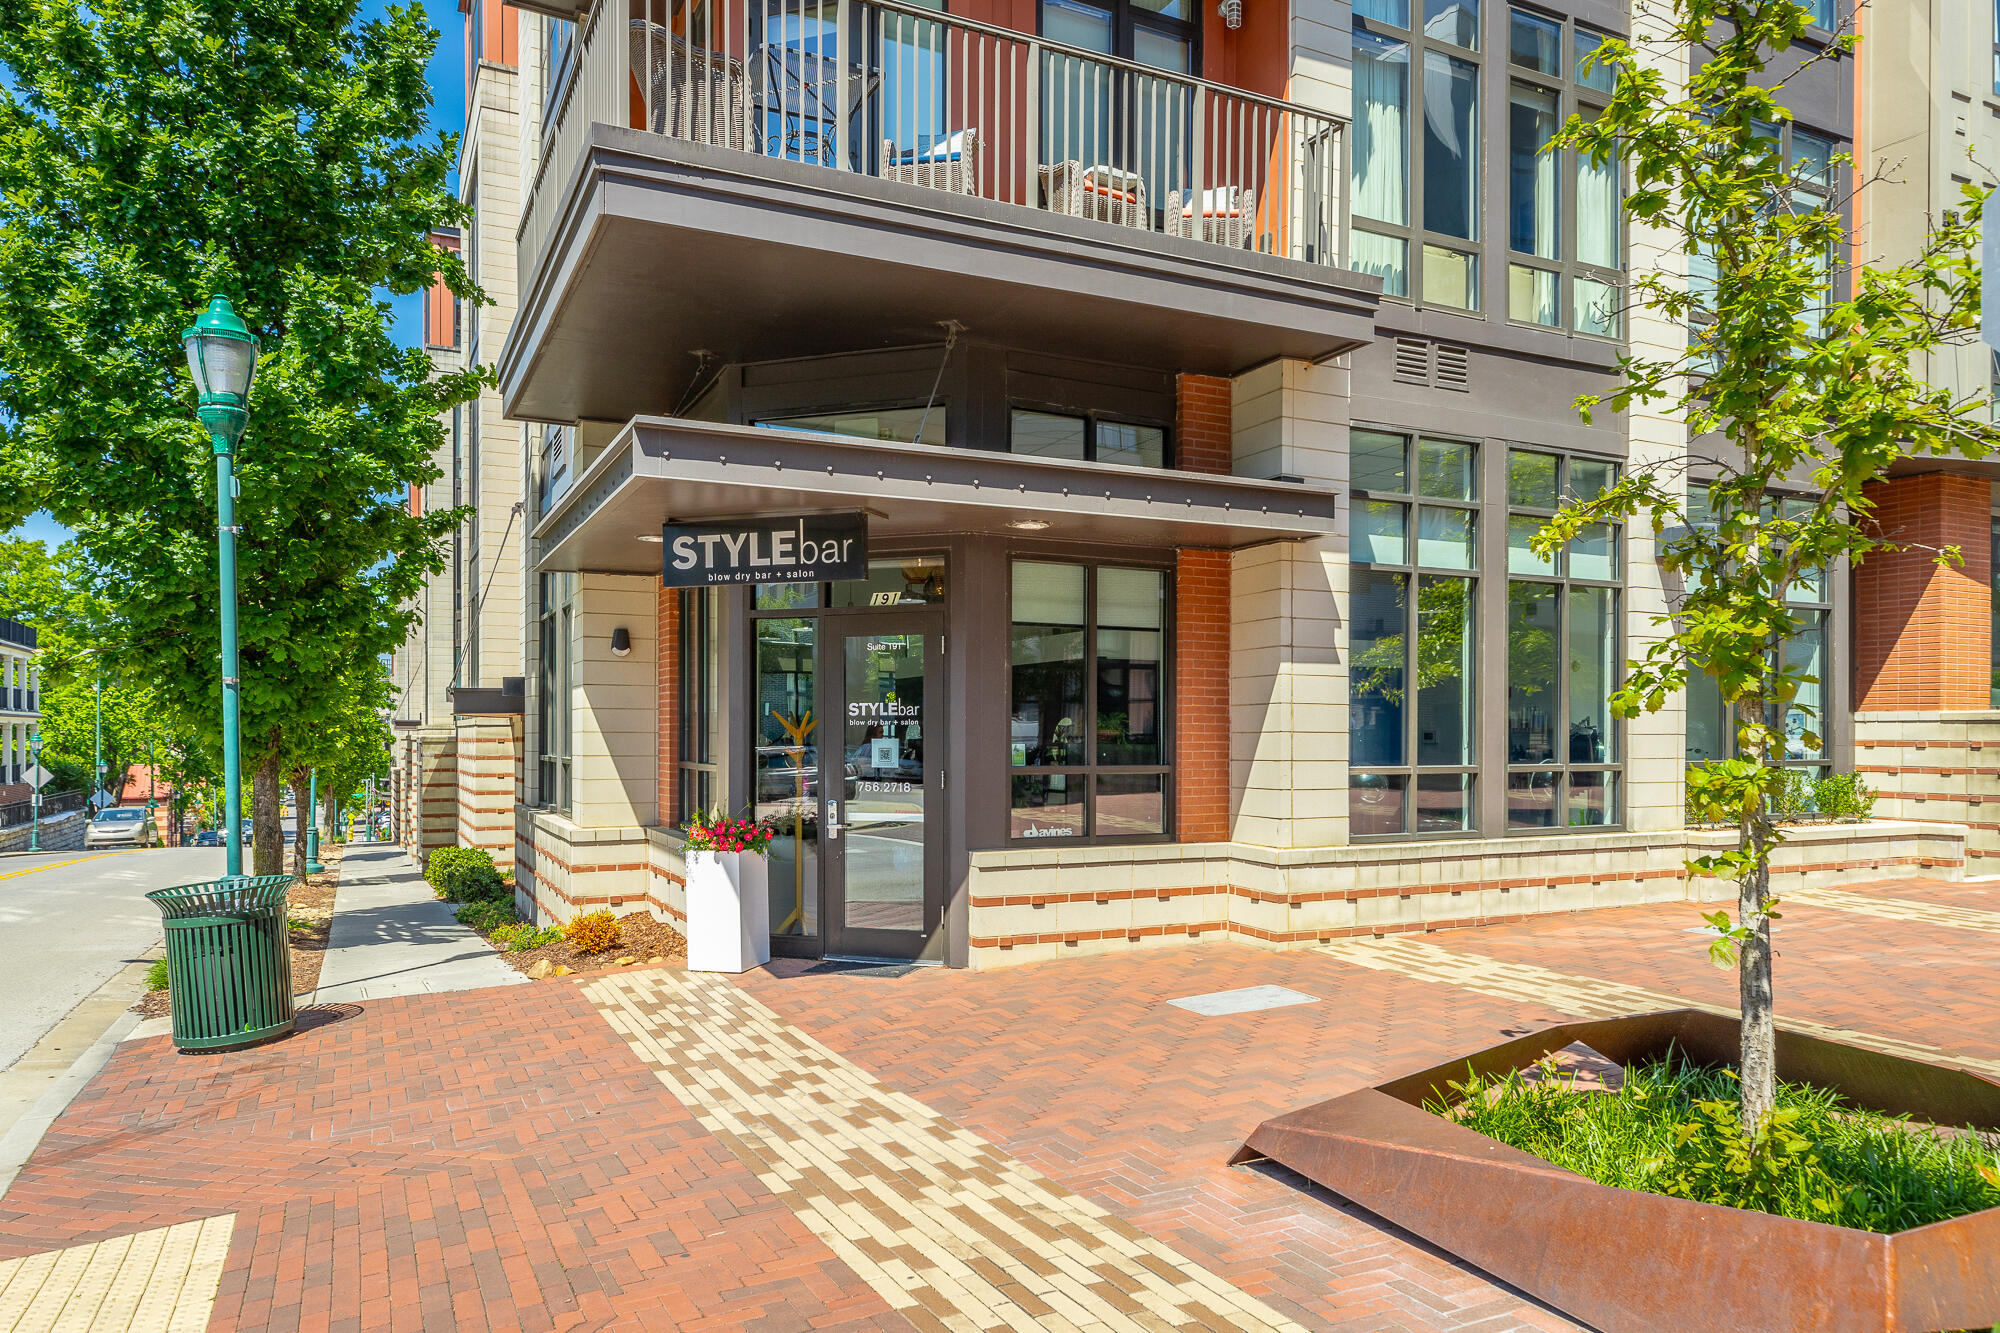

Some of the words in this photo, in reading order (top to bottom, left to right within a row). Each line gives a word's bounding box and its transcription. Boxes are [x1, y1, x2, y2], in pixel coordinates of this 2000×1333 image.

[672, 519, 853, 570] STYLEbar
[708, 573, 731, 582] blow
[735, 572, 751, 582] dry
[755, 571, 771, 580] bar
[786, 570, 815, 579] salon
[873, 593, 898, 605] 191
[867, 642, 886, 651] Suite
[848, 697, 920, 716] STYLEbar
[867, 719, 878, 727] dry
[857, 781, 912, 793] 756.2718
[1023, 822, 1073, 838] davines
